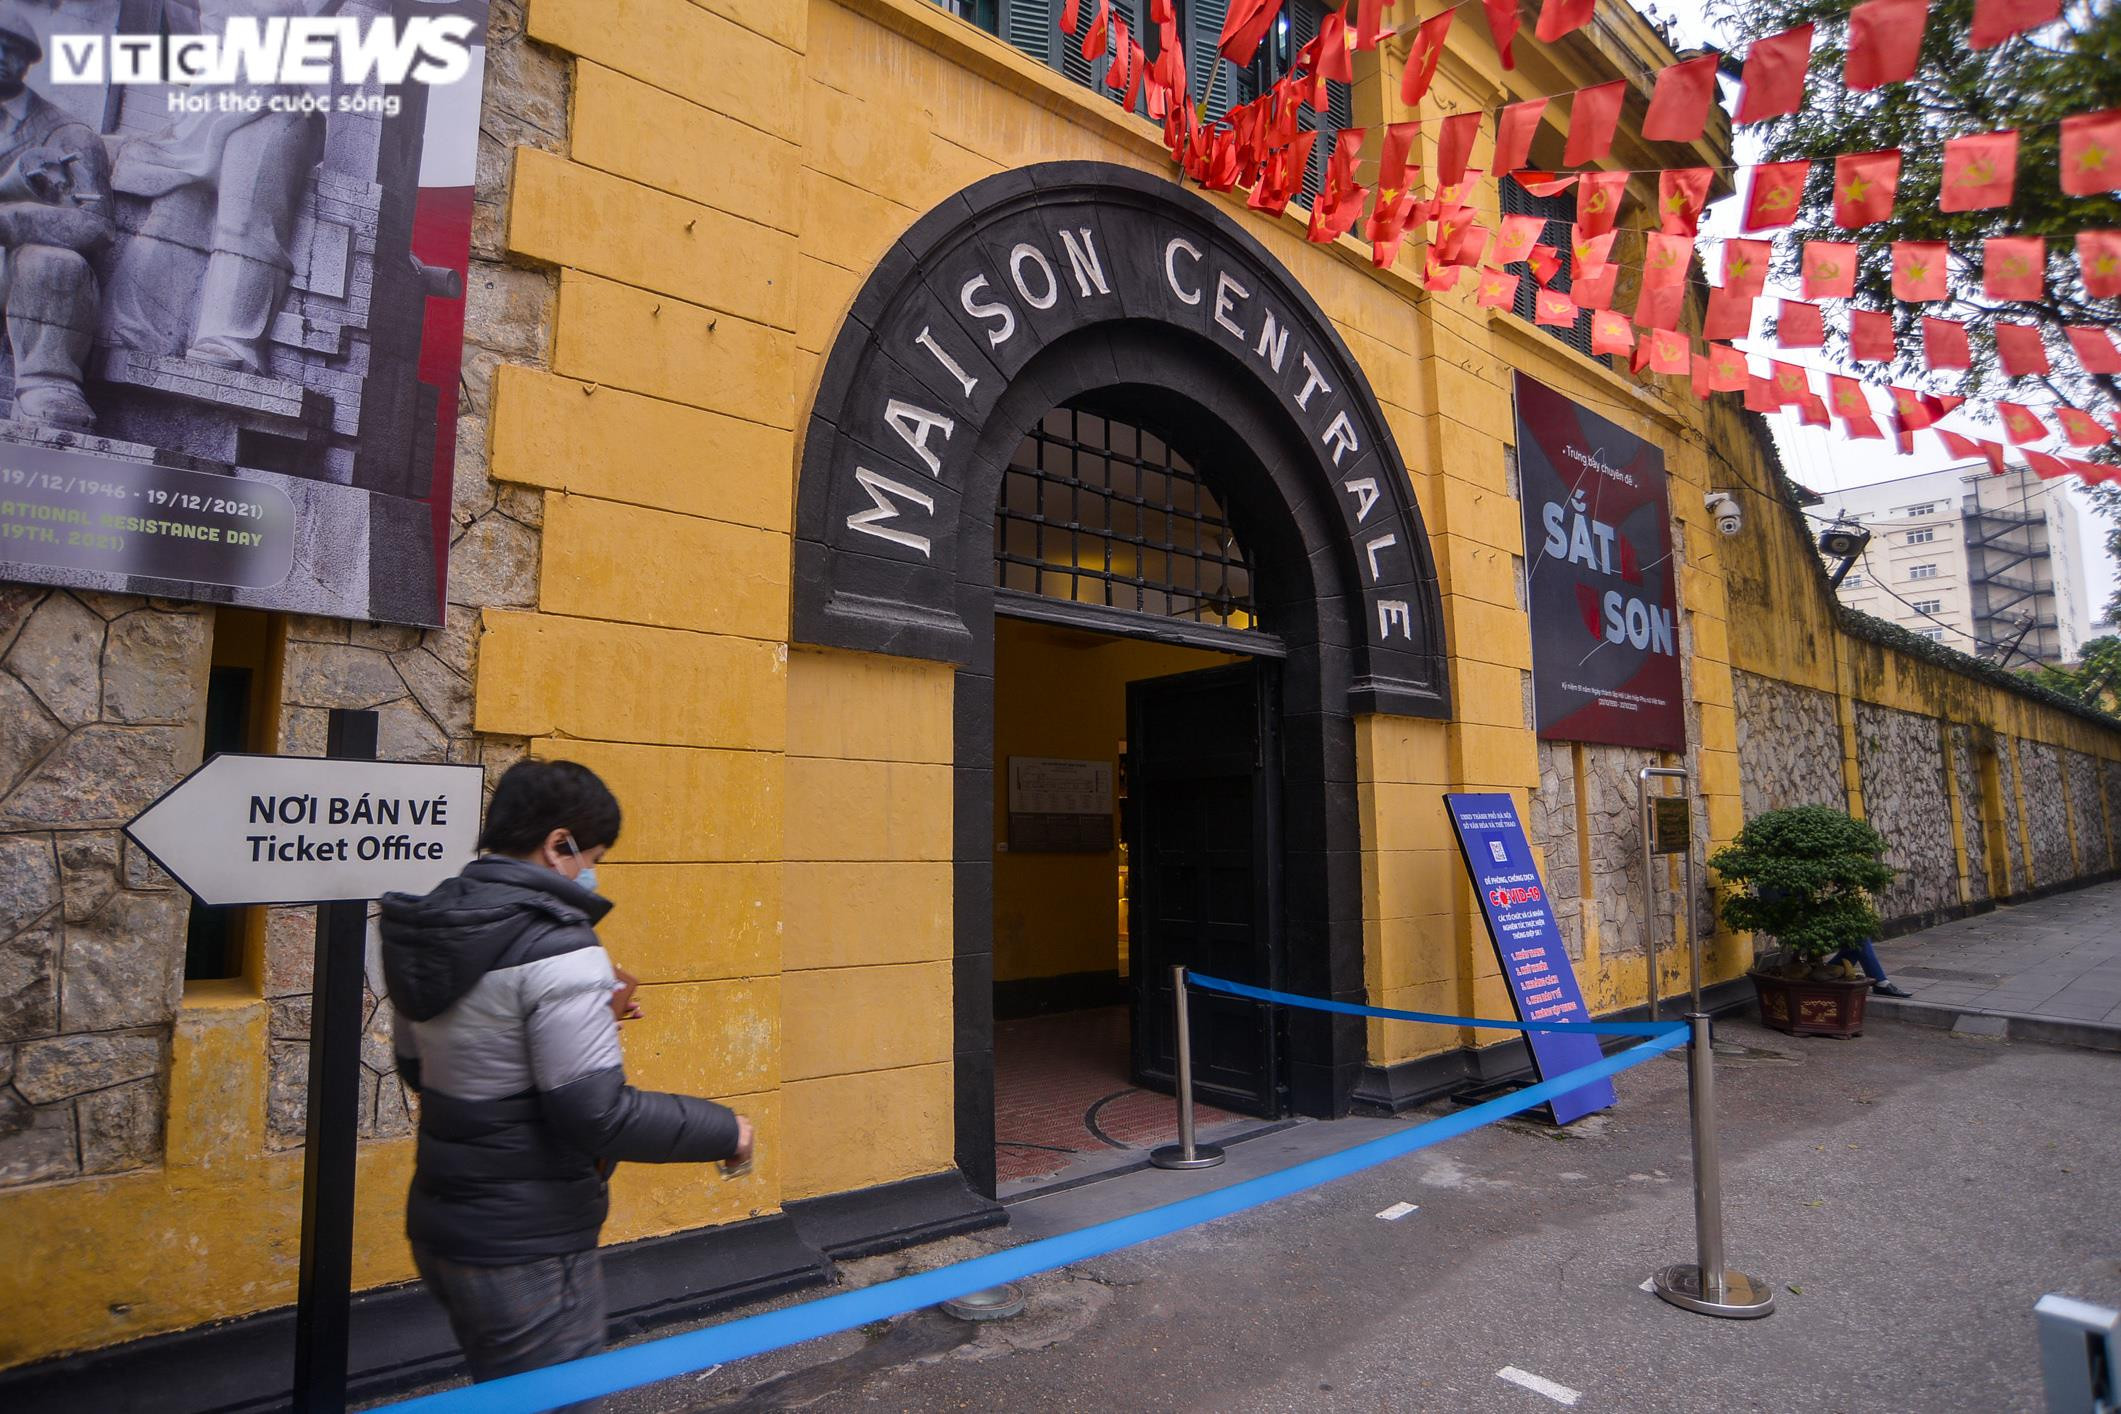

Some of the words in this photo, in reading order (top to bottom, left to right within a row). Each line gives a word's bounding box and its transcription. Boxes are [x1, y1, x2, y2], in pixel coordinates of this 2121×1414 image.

[846, 227, 1111, 559] MAISON
[1165, 237, 1413, 641] CENTRALE
[0, 469, 126, 499] 19/12/1946
[147, 489, 264, 520] 19/12/2021)
[1, 501, 91, 526] ATIONAL
[101, 516, 220, 542] RESISTANCE
[227, 529, 263, 547] DAY
[68, 531, 125, 553] 2021)
[1542, 489, 1616, 576] SẮT
[1603, 590, 1673, 657] SON
[249, 793, 318, 824] NƠI
[328, 792, 399, 825] BÁN
[408, 794, 448, 826] VÉ
[246, 835, 348, 862] Ticket
[356, 834, 444, 860] Office
